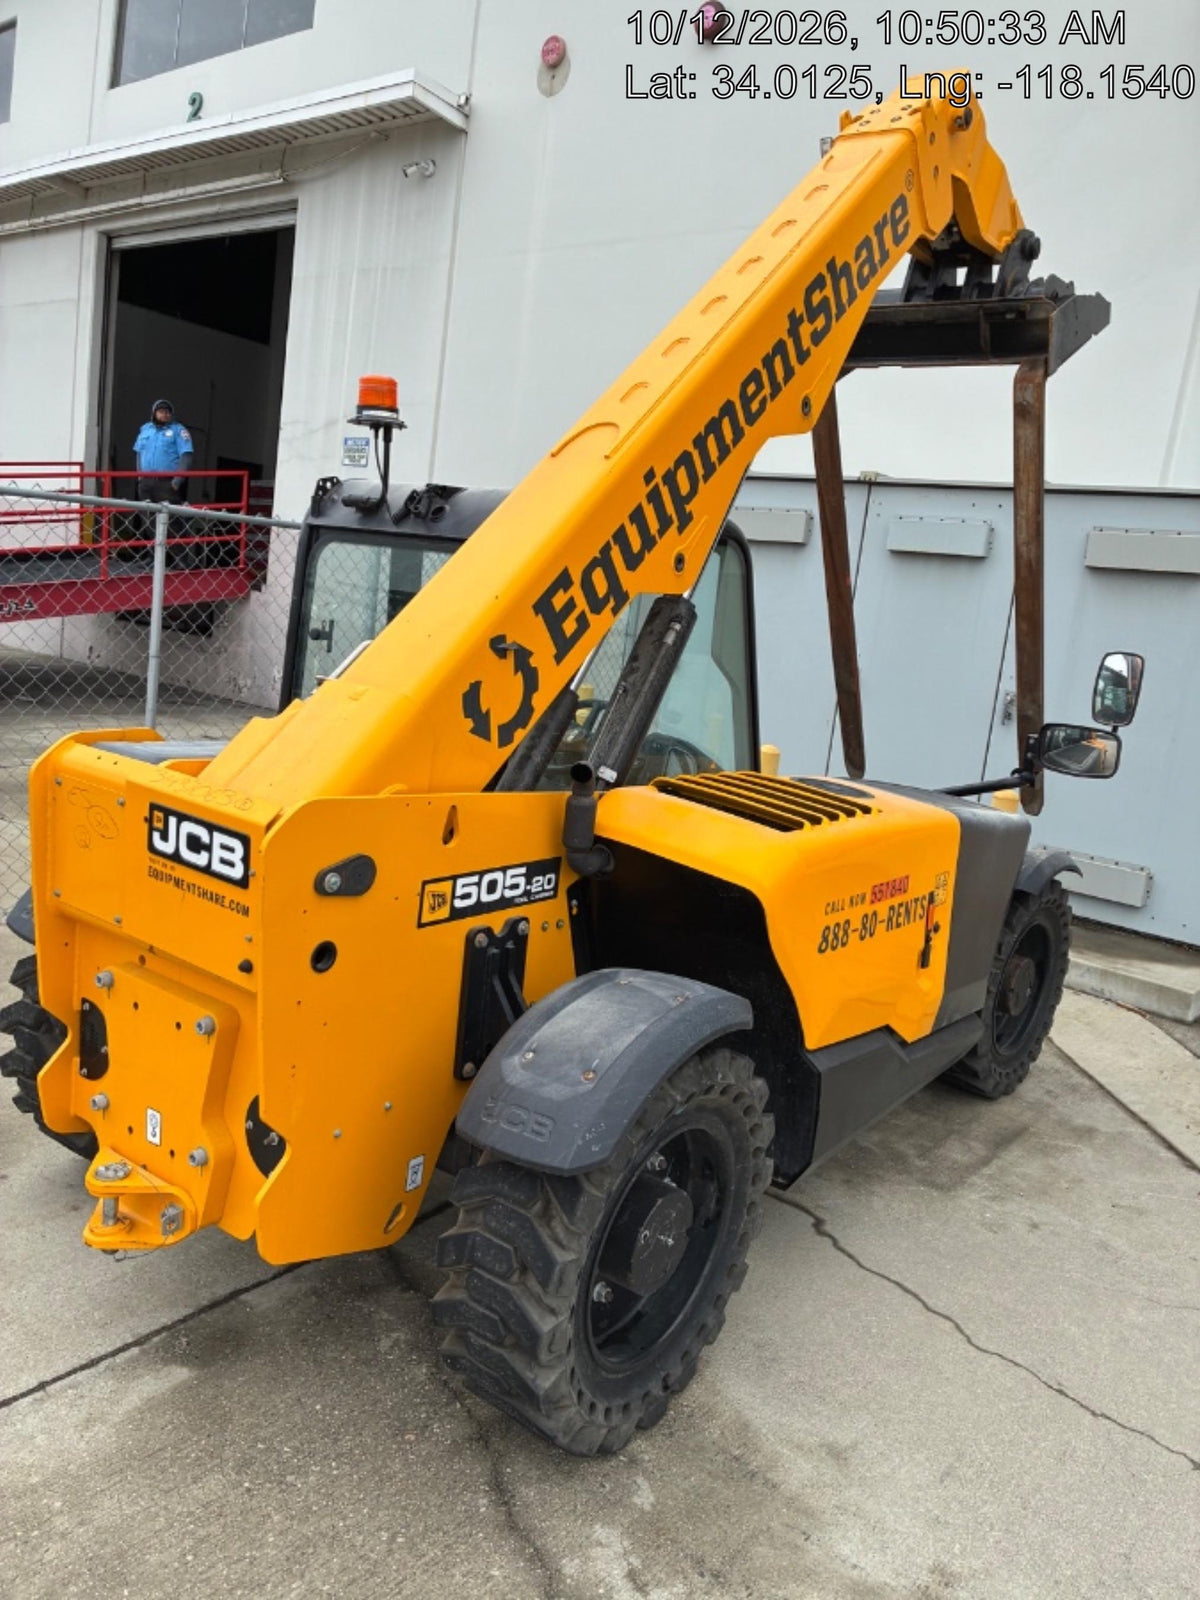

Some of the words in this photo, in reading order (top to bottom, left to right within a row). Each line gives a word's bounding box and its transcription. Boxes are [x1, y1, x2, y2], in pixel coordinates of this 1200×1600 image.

[186, 91, 203, 123] 2
[152, 815, 244, 880] JCB
[148, 865, 250, 918] EQUIPMENTSHARE.COM
[824, 898, 846, 916] CALL
[849, 891, 867, 909] NOW
[817, 894, 927, 954] 888-80-RENTS
[481, 1096, 557, 1143] JCB
